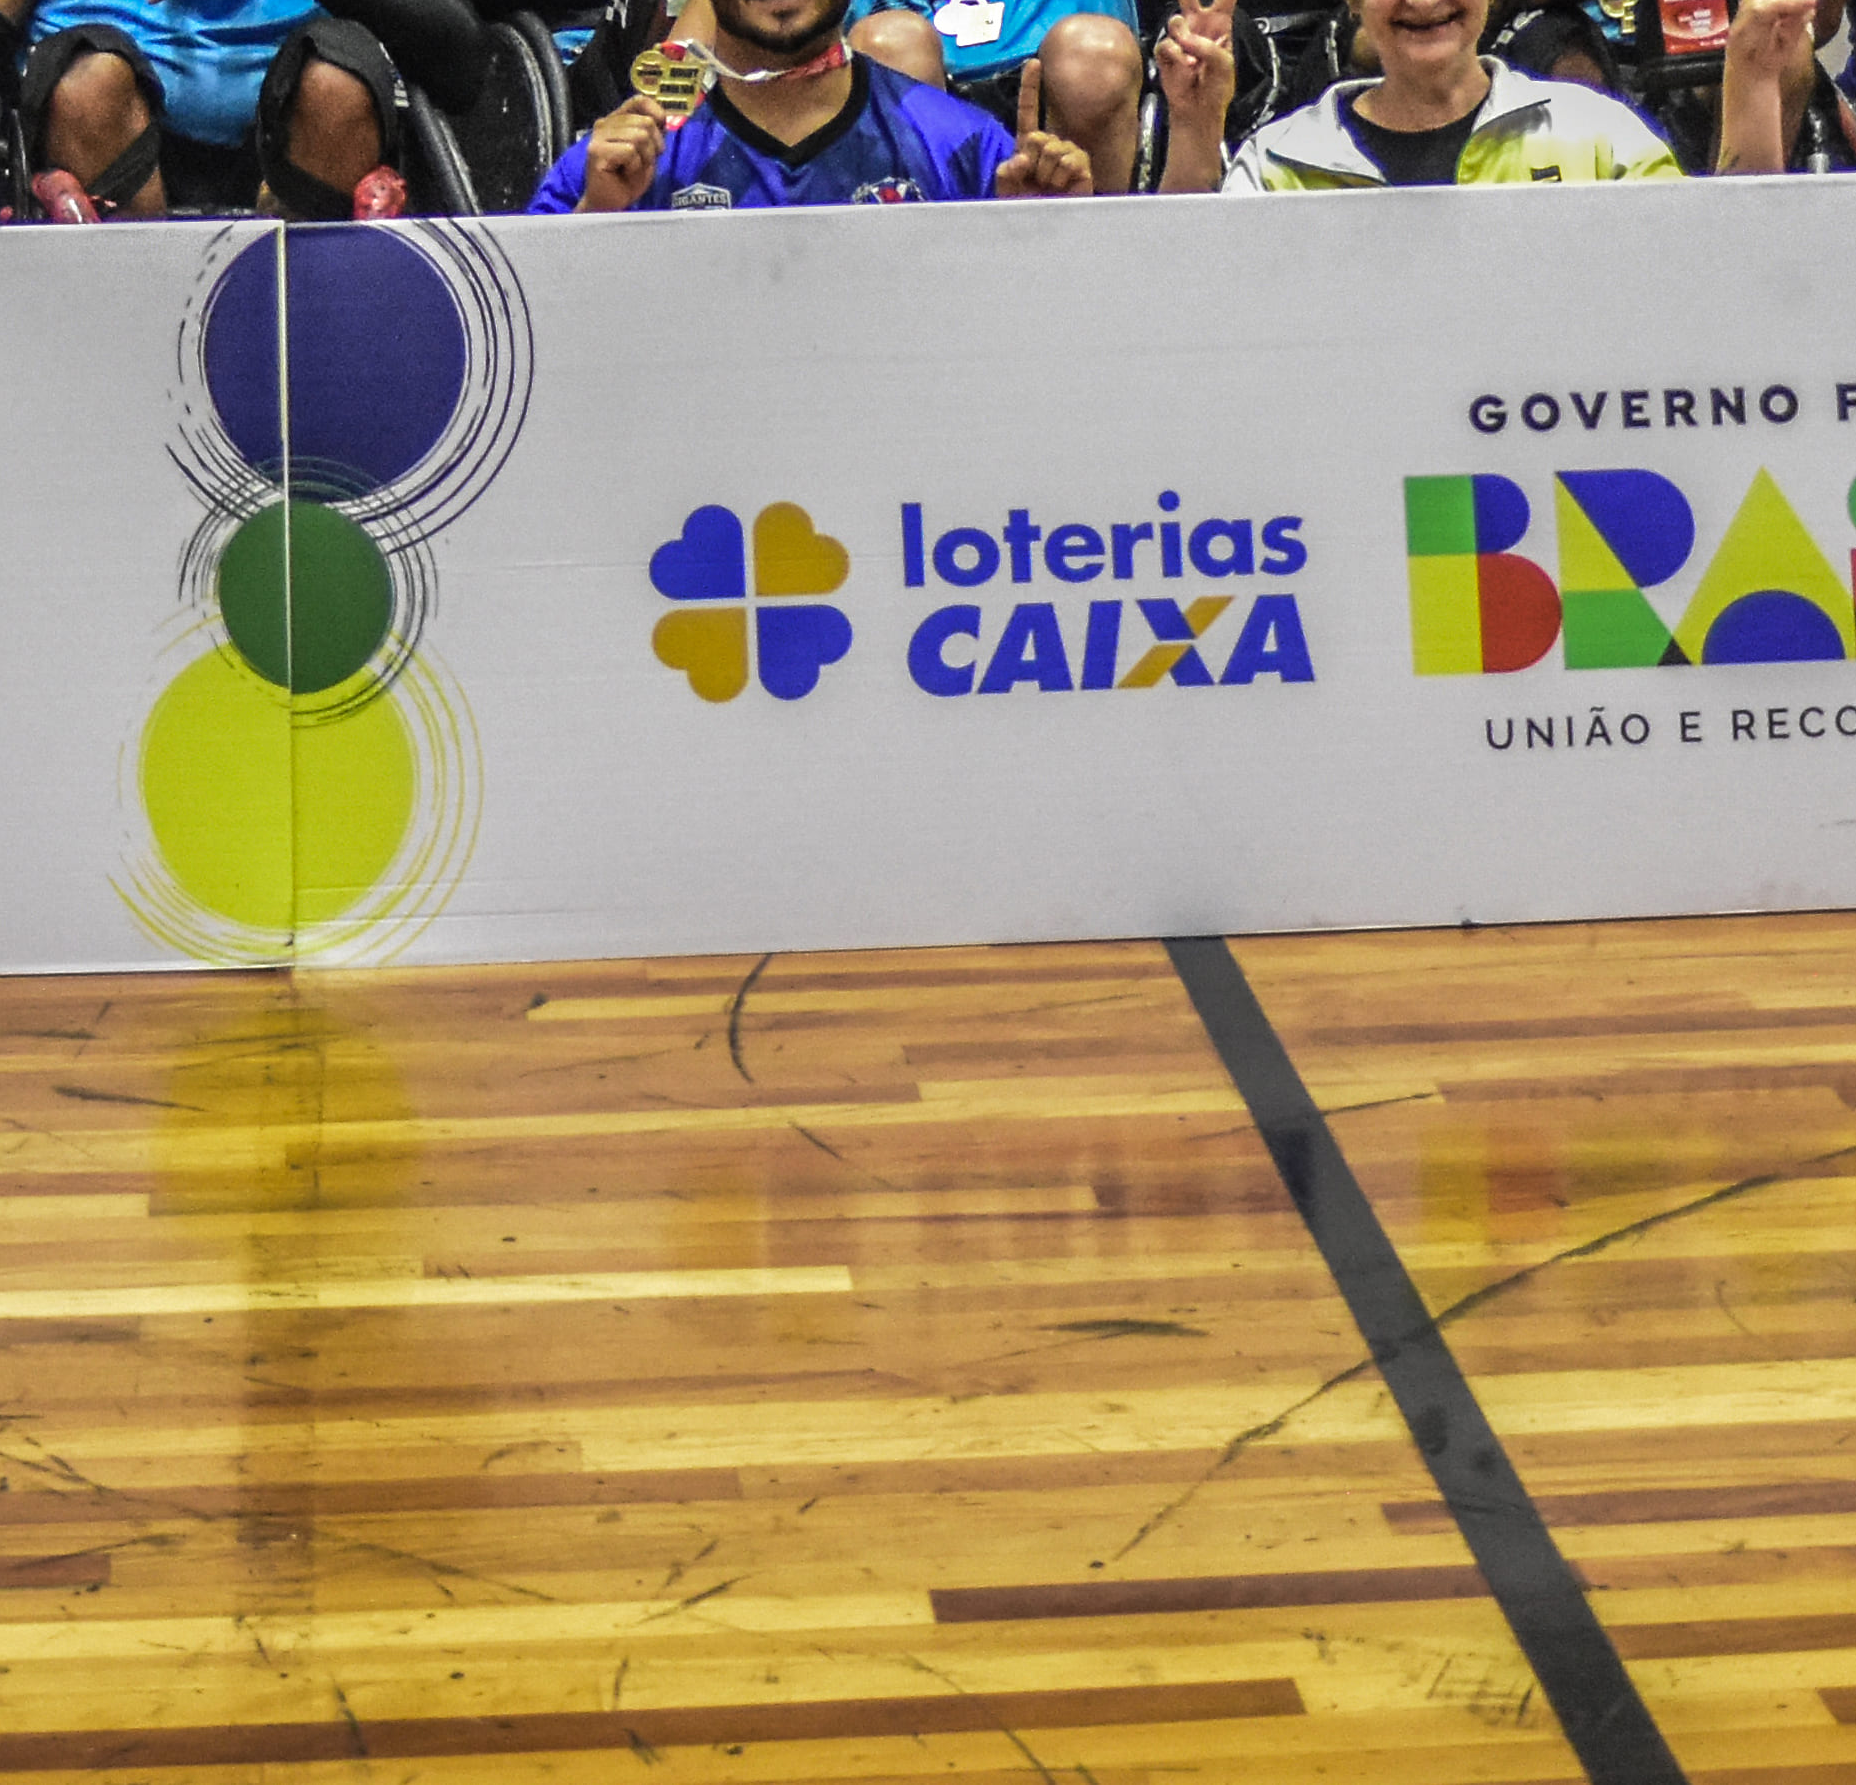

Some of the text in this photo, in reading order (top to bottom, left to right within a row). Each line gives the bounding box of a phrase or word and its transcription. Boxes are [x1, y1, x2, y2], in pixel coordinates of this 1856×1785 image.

[1469, 384, 1800, 434] GOVERNO
[901, 489, 1308, 588] loterias
[906, 594, 1316, 698] CAIXA
[1485, 706, 1651, 751] UNIÃO
[1681, 712, 1702, 743] E
